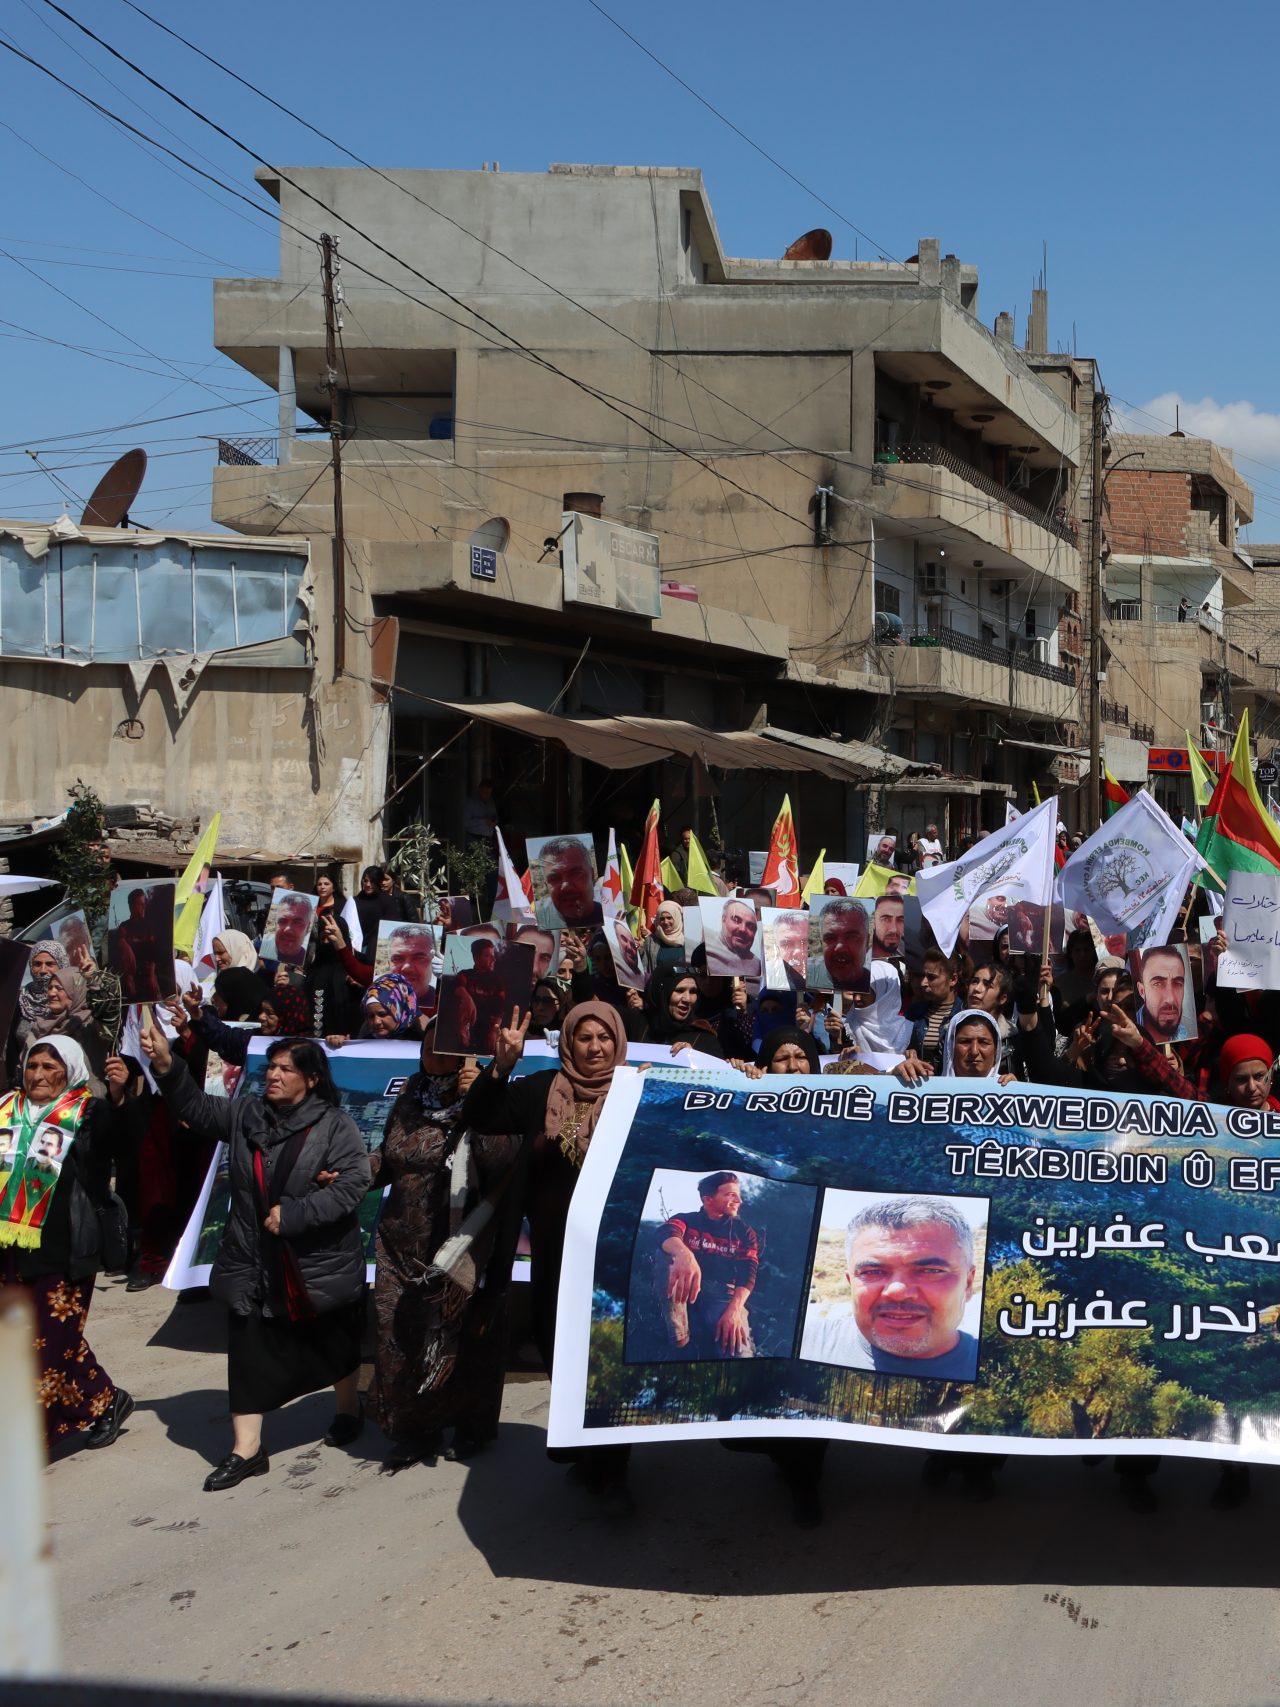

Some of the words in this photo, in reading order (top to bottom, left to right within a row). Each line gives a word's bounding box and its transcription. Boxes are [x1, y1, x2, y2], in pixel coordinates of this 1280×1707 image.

[611, 538, 645, 561] OSCAR
[1258, 767, 1276, 775] TOP
[683, 1090, 734, 1112] BI
[745, 1086, 876, 1122] RÛHÊ
[888, 1092, 1217, 1138] BERXWEDANA
[945, 1140, 1168, 1184] TÊKBIBIN
[1182, 1150, 1214, 1188] Û
[1022, 1214, 1165, 1259] عفرين
[999, 1289, 1148, 1339] عفرين
[1163, 1300, 1257, 1340] نحرر
